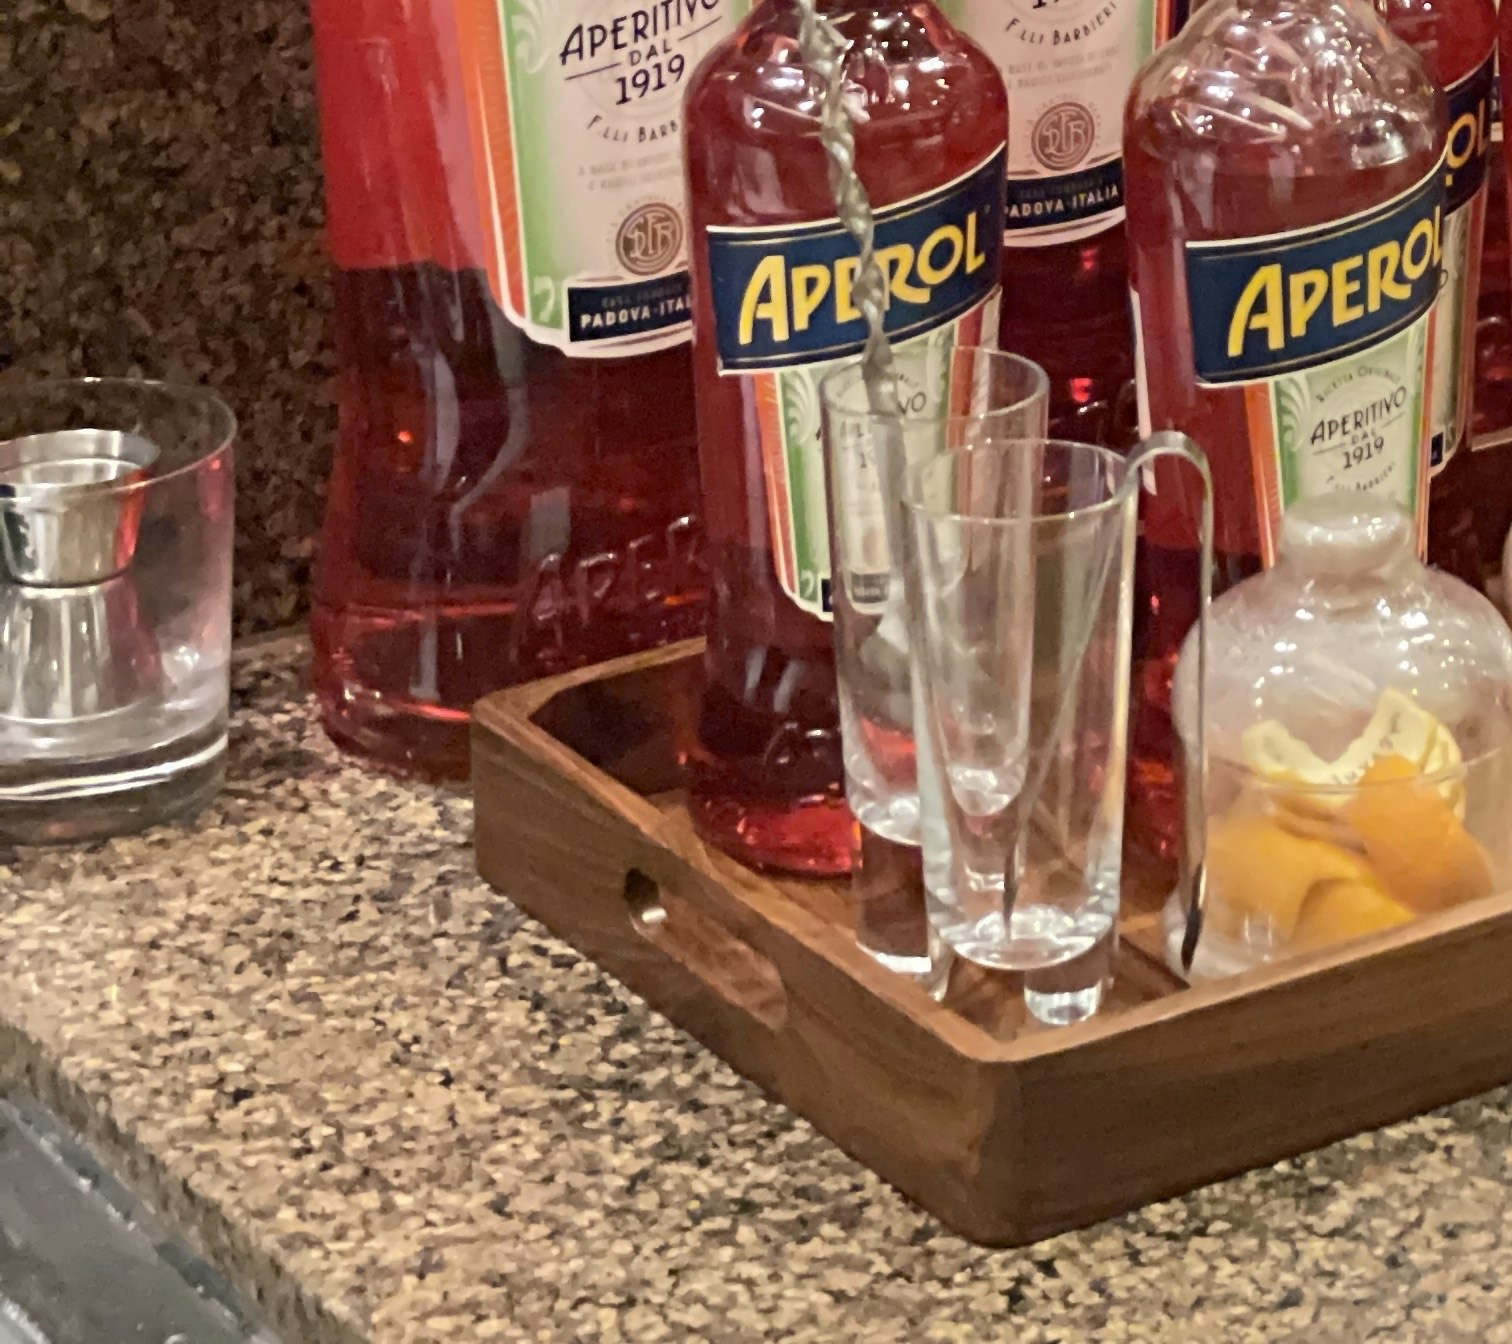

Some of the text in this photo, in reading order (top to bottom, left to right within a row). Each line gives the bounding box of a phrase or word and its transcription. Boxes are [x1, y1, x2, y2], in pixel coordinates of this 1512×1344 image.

[628, 39, 673, 67] DAL
[615, 53, 686, 106] 1919
[638, 119, 679, 144] BARB
[1072, 184, 1120, 209] ITALIA
[738, 211, 986, 346] APEROL
[1226, 204, 1443, 358] APEROL
[579, 304, 652, 330] PADOVA
[1309, 385, 1408, 447] APERITIVO
[1342, 435, 1386, 471] 1919
